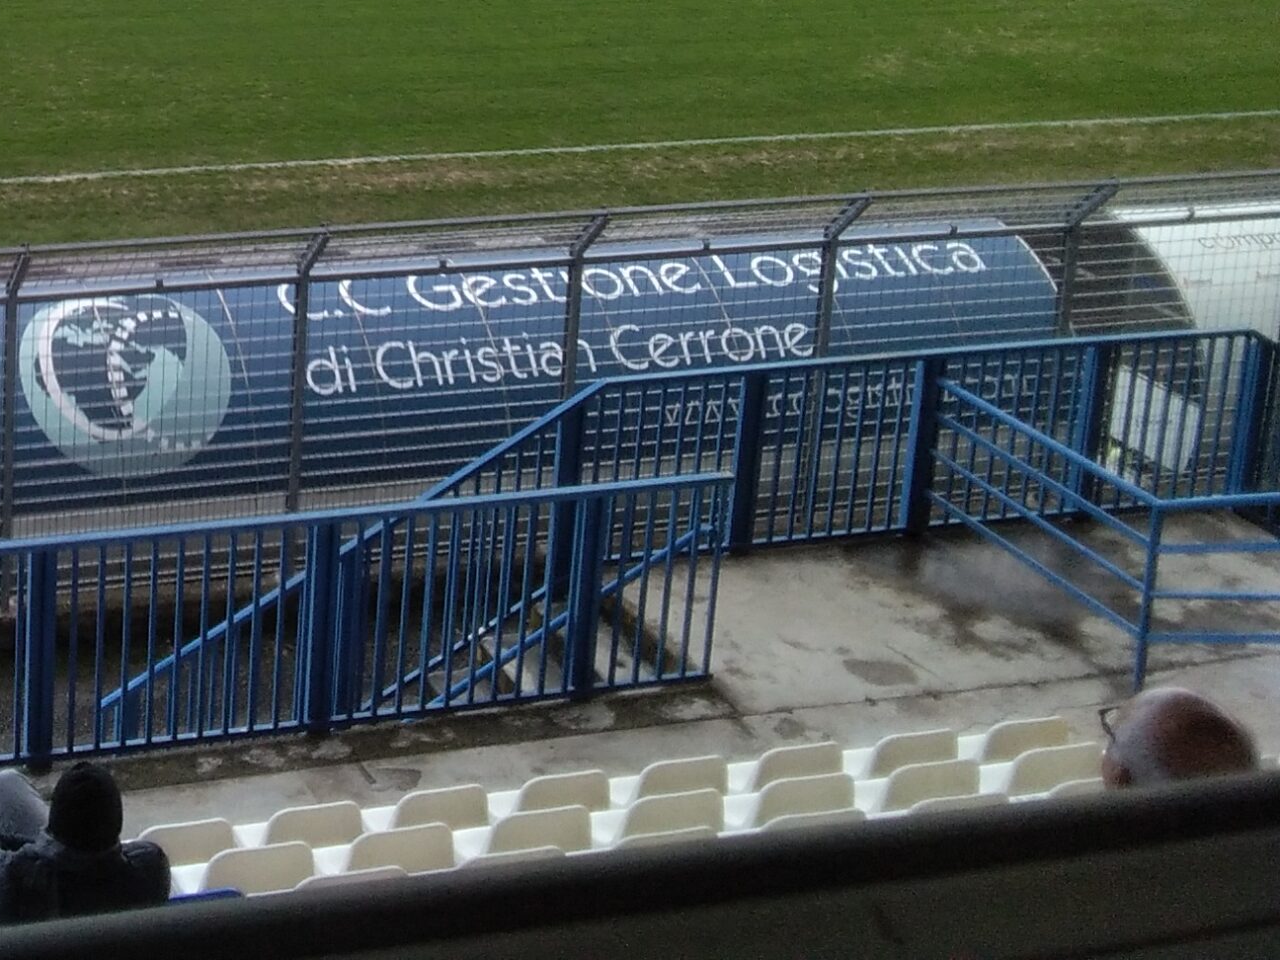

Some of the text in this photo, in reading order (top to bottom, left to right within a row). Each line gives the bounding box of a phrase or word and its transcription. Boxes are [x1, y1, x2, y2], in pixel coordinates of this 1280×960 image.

[724, 240, 985, 294] Logistica
[306, 321, 815, 397] di Christian Cerrone
